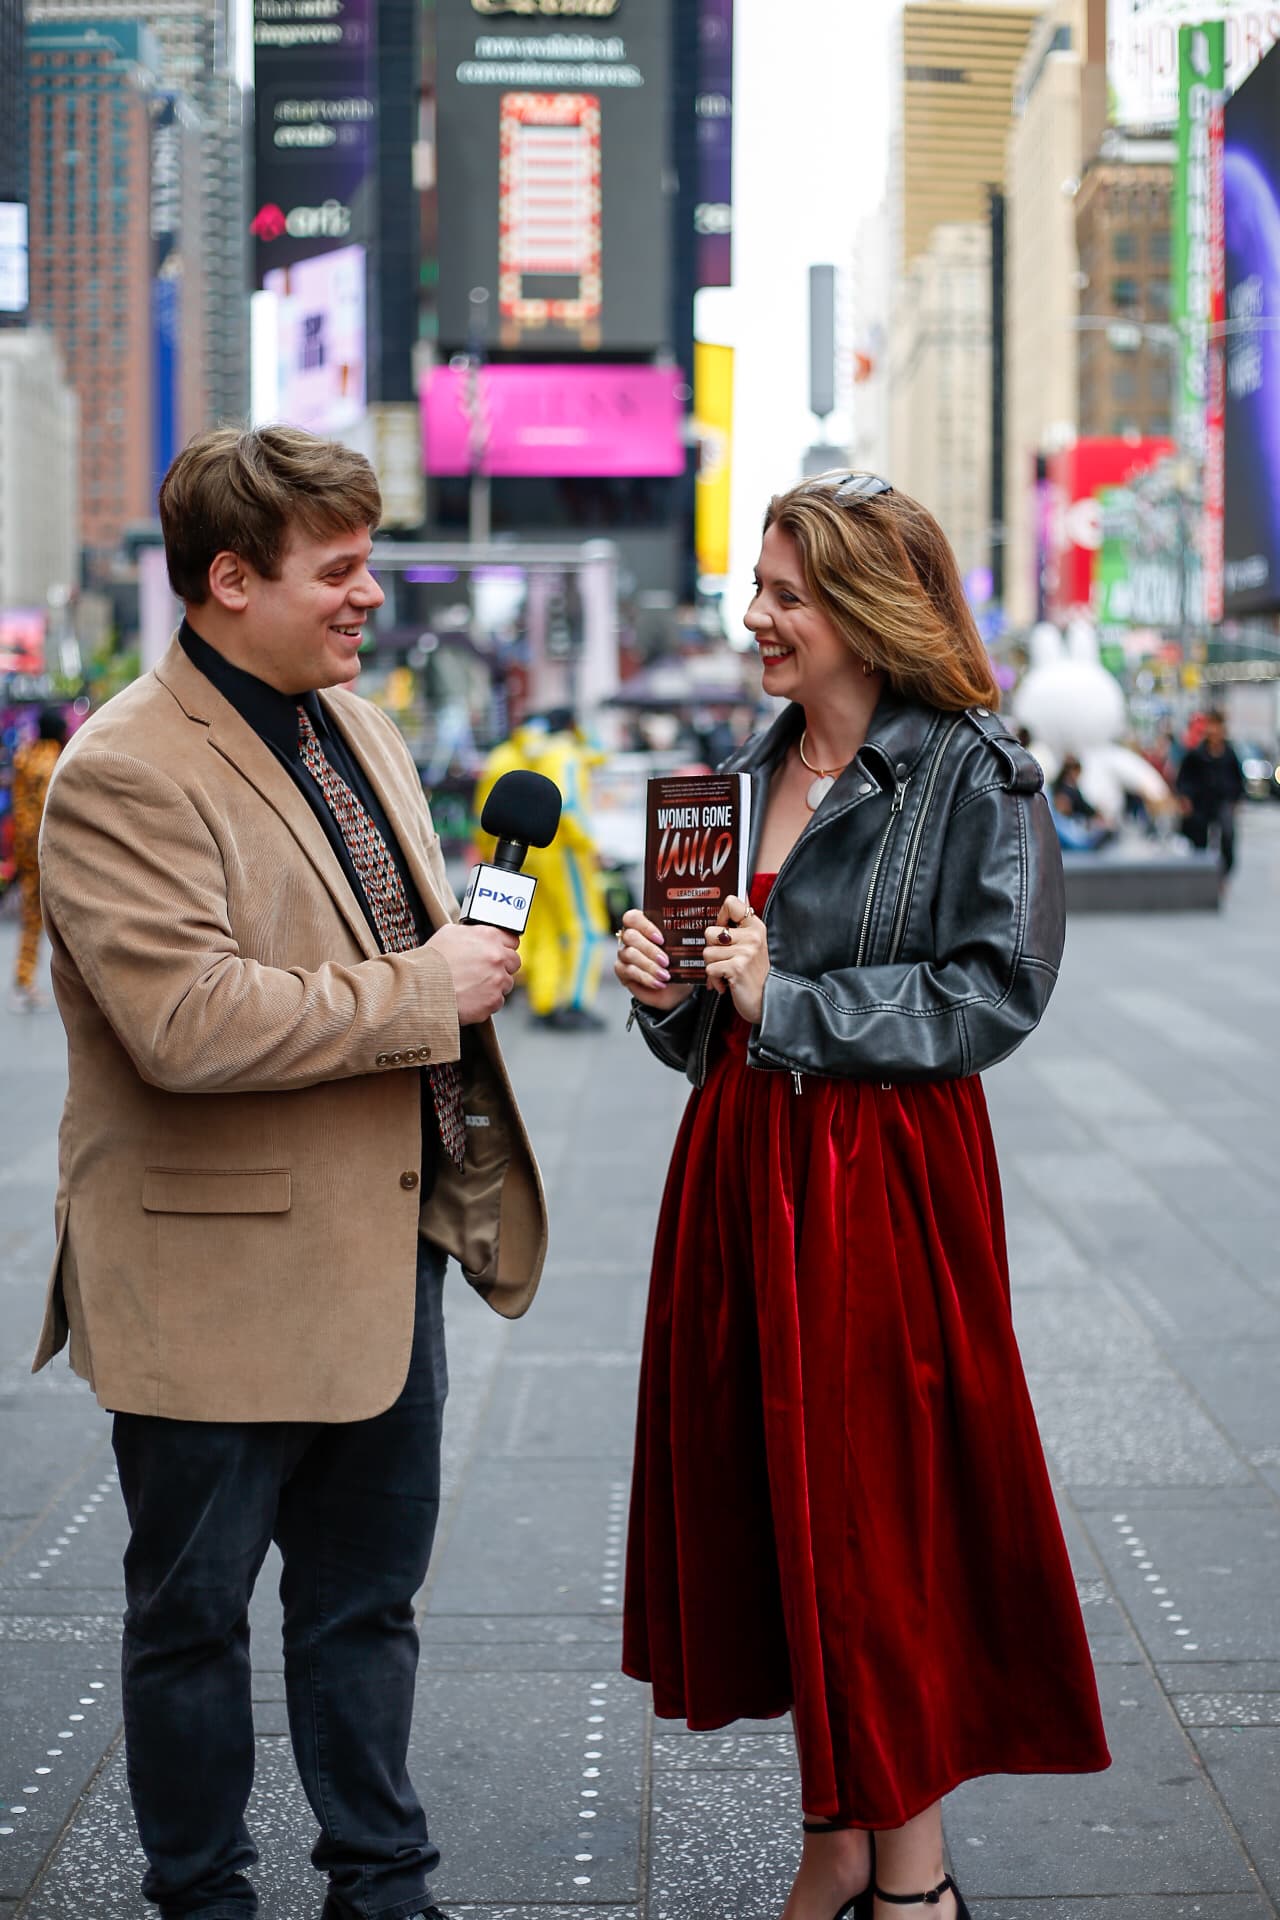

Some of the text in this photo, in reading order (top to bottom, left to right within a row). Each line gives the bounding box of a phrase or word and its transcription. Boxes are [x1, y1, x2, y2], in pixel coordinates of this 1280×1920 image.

[657, 805, 732, 829] WOMEN GONE
[656, 824, 732, 882] WILD
[676, 888, 711, 897] LEADERSHIP
[663, 919, 672, 929] TO
